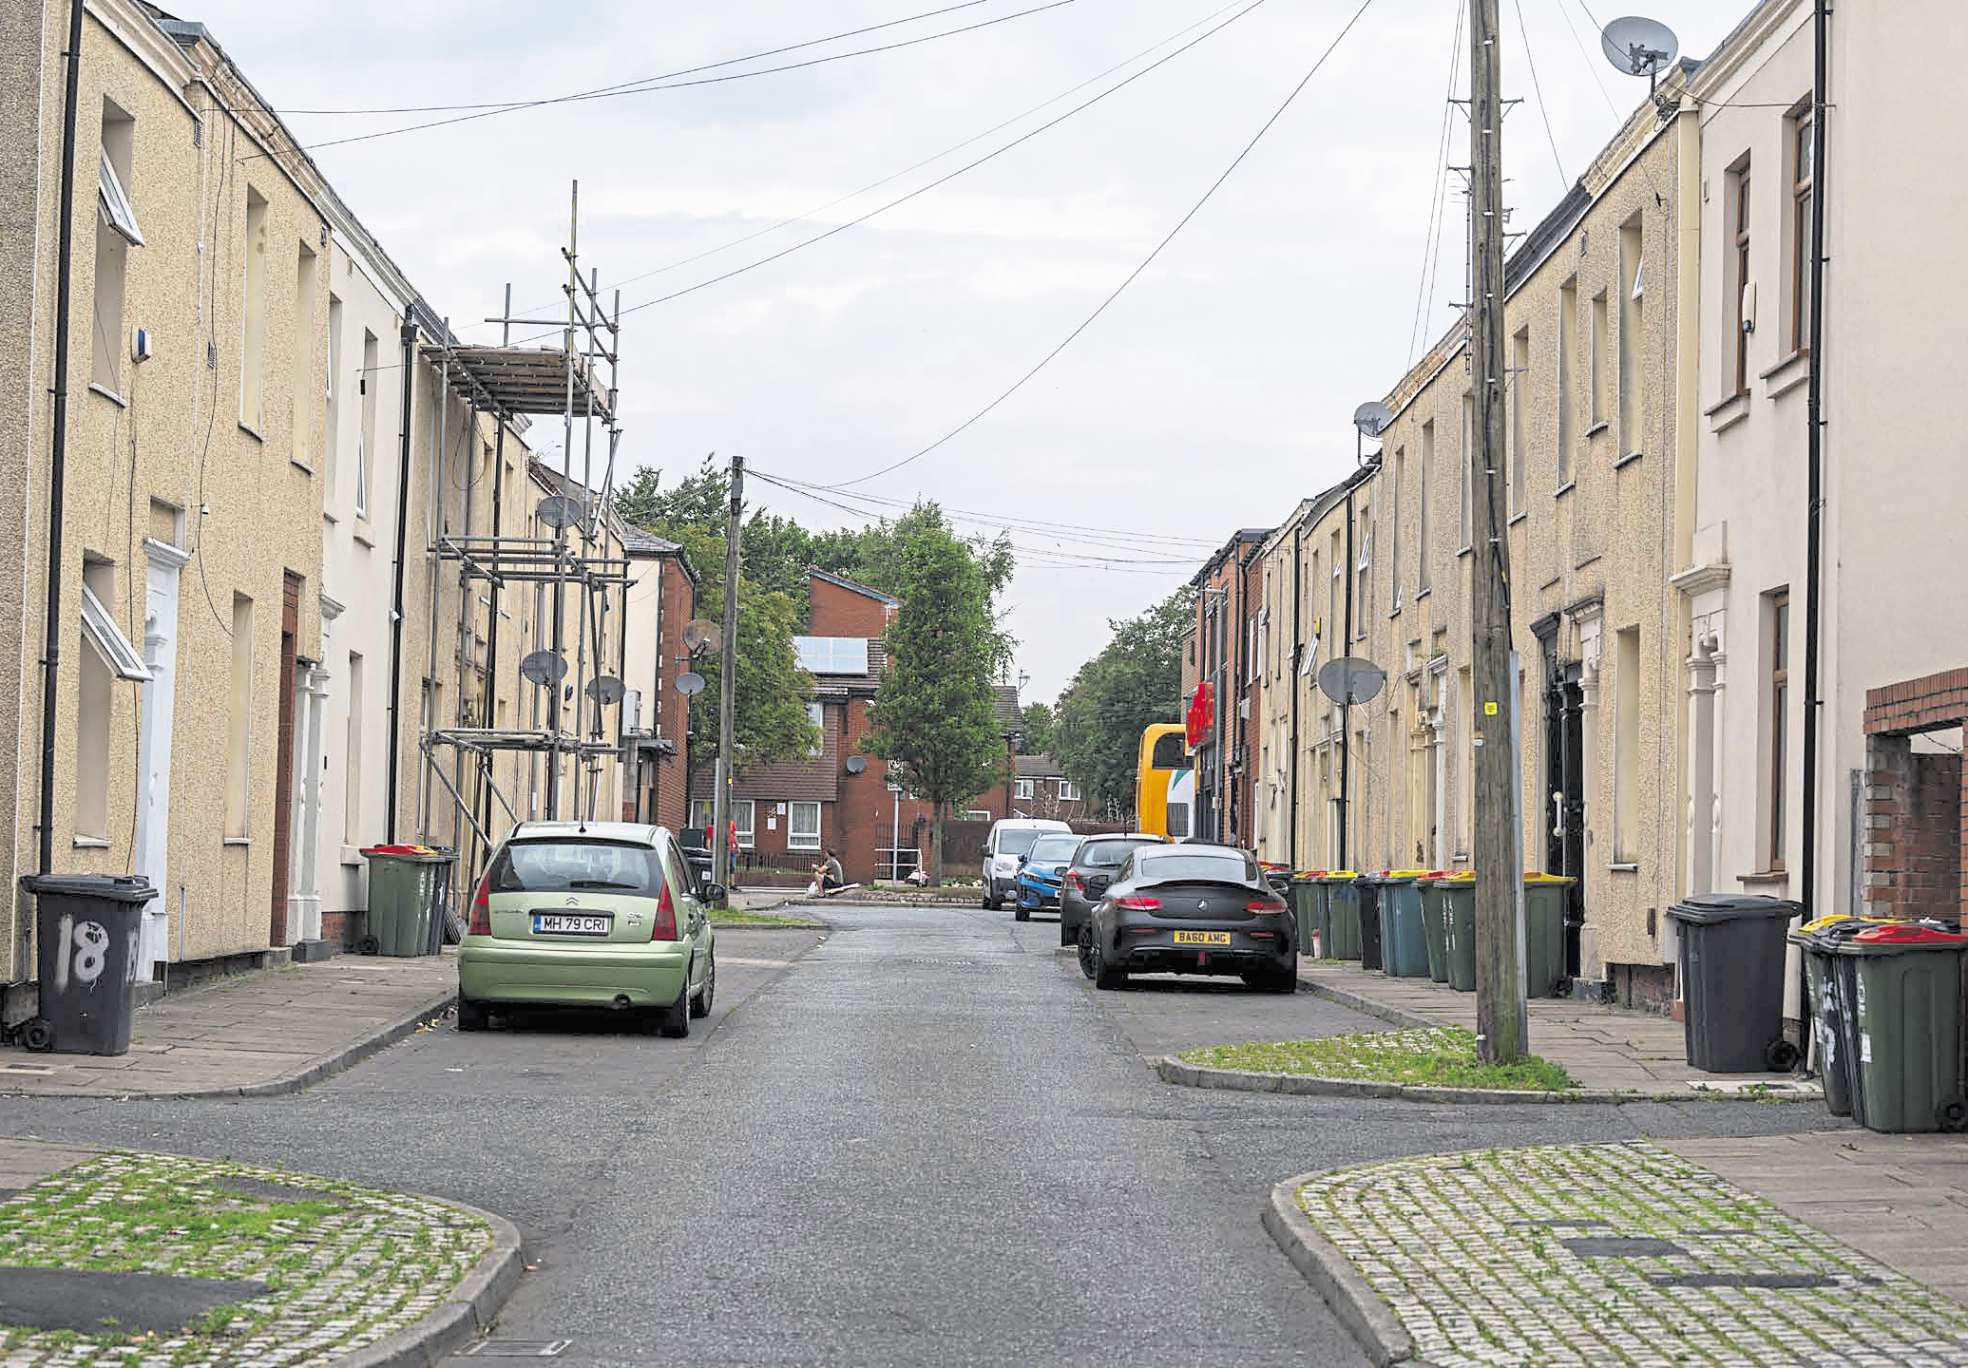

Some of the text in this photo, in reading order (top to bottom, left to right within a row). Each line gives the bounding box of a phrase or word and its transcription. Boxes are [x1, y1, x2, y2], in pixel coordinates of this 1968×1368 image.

[543, 917, 606, 931] MH 79 CRI
[1178, 932, 1205, 943] BA60
[54, 912, 110, 992] 18
